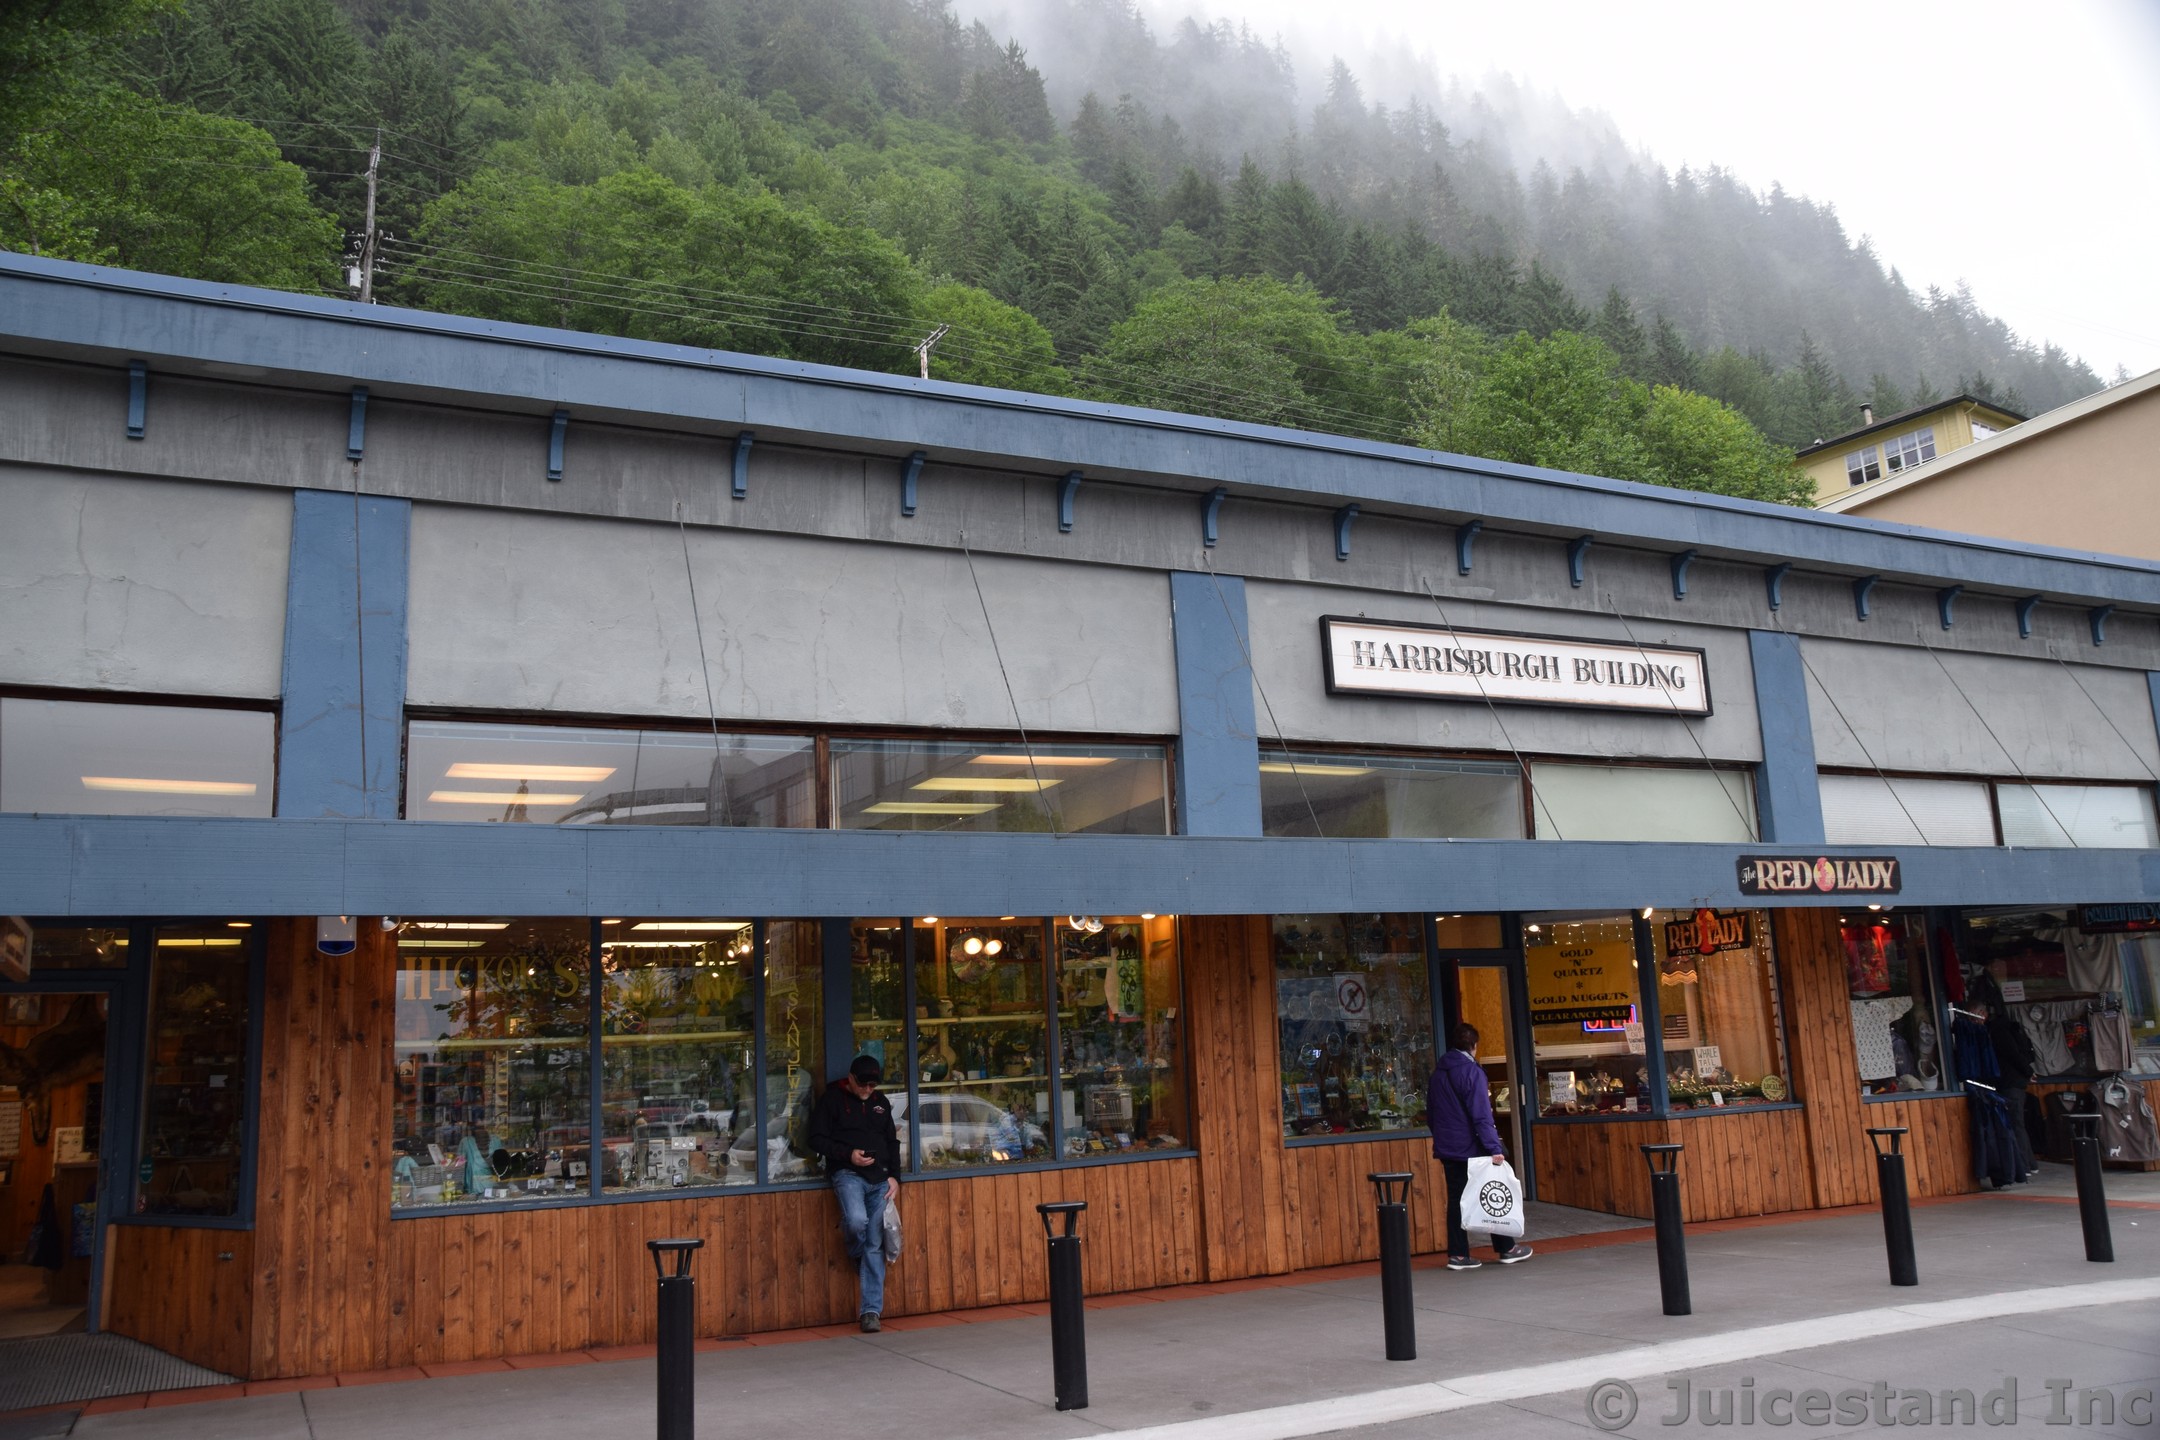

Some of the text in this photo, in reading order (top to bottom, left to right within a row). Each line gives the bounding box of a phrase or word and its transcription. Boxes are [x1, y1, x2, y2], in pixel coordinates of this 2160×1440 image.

[1352, 640, 1686, 691] HARRISBURGH BUILDING
[1741, 859, 1897, 890] The RED LADY
[1667, 915, 1746, 951] RED LADY
[1560, 948, 1594, 958] GOLD
[1553, 967, 1604, 979] QUARTZ
[1533, 991, 1629, 1005] GOLD NUGGETS
[1535, 1009, 1629, 1021] CLEARANCE SALE
[1696, 1047, 1718, 1059] WHALE
[1699, 1059, 1717, 1067] TAIL
[1482, 1182, 1511, 1196] JUNEAU
[1481, 1198, 1512, 1216] TRADING
